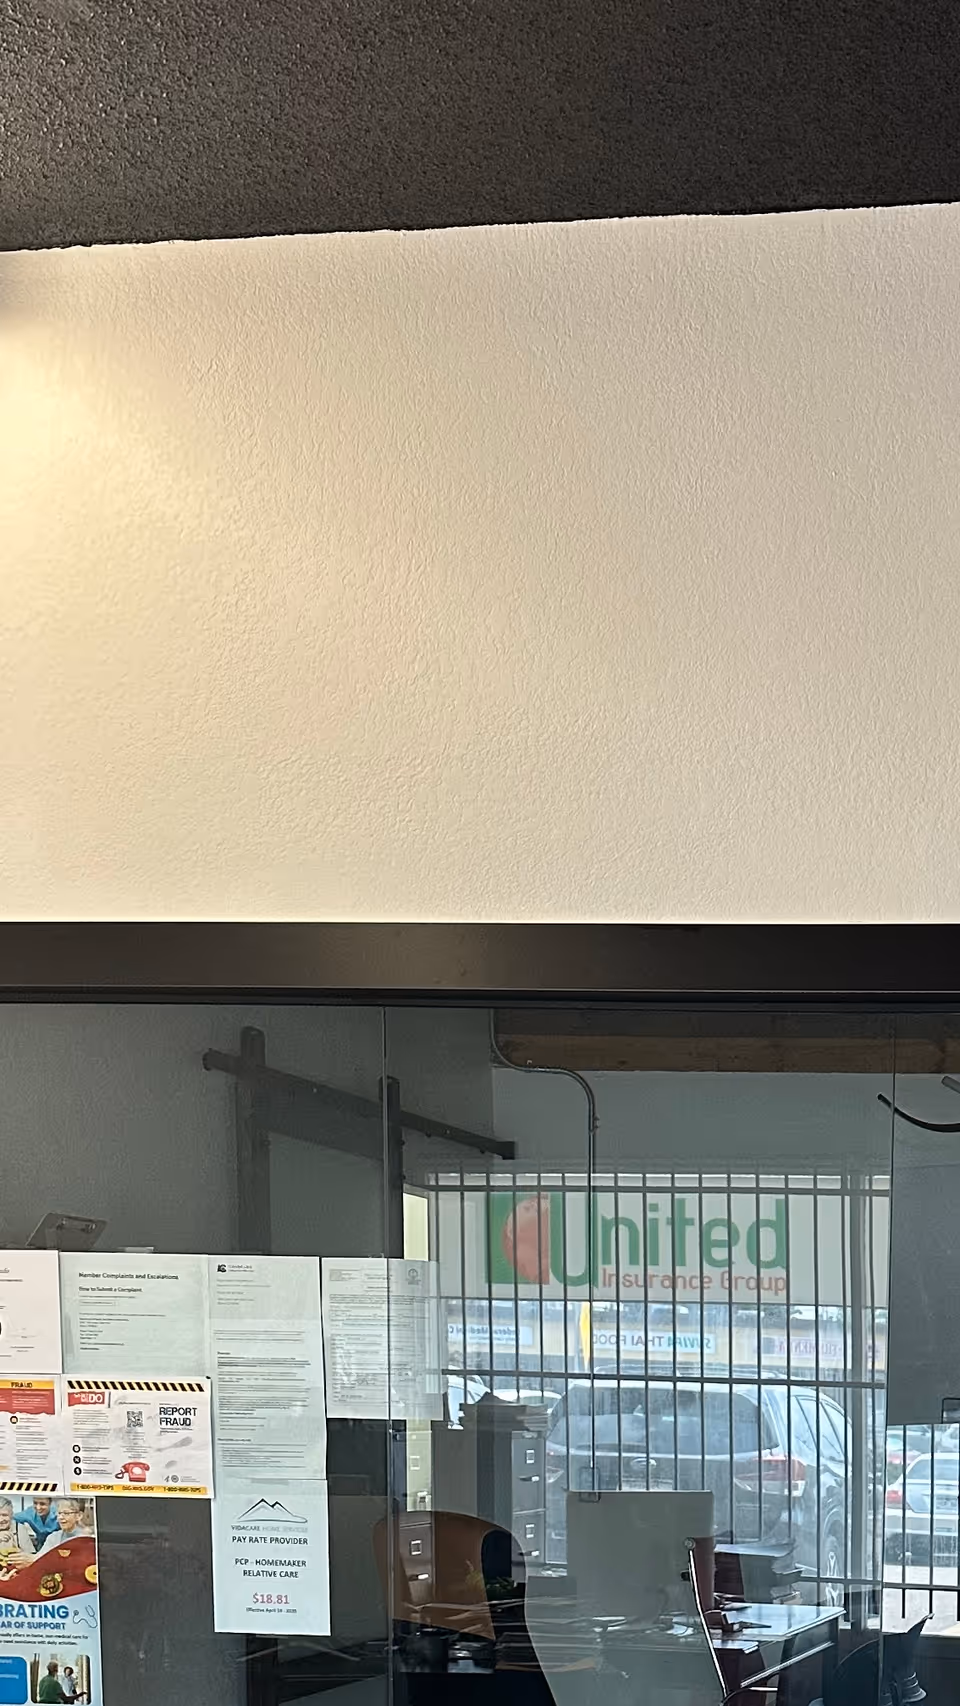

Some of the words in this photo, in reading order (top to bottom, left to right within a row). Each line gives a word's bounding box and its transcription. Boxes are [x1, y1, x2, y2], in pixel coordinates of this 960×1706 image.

[550, 1192, 787, 1288] United
[602, 1269, 713, 1290] Insurance
[720, 1270, 787, 1296] Group
[159, 1407, 198, 1417] REPORT
[160, 1417, 191, 1427] FRAUD
[249, 1536, 268, 1544] RATE
[270, 1537, 308, 1545] PROVIDER
[235, 1558, 249, 1566] PCP
[255, 1558, 307, 1567] HOMEMAKER
[279, 1570, 299, 1578] CARE
[252, 1592, 290, 1604] $18.81
[14, 1621, 25, 1629] OF
[27, 1621, 66, 1630] SUPPORT
